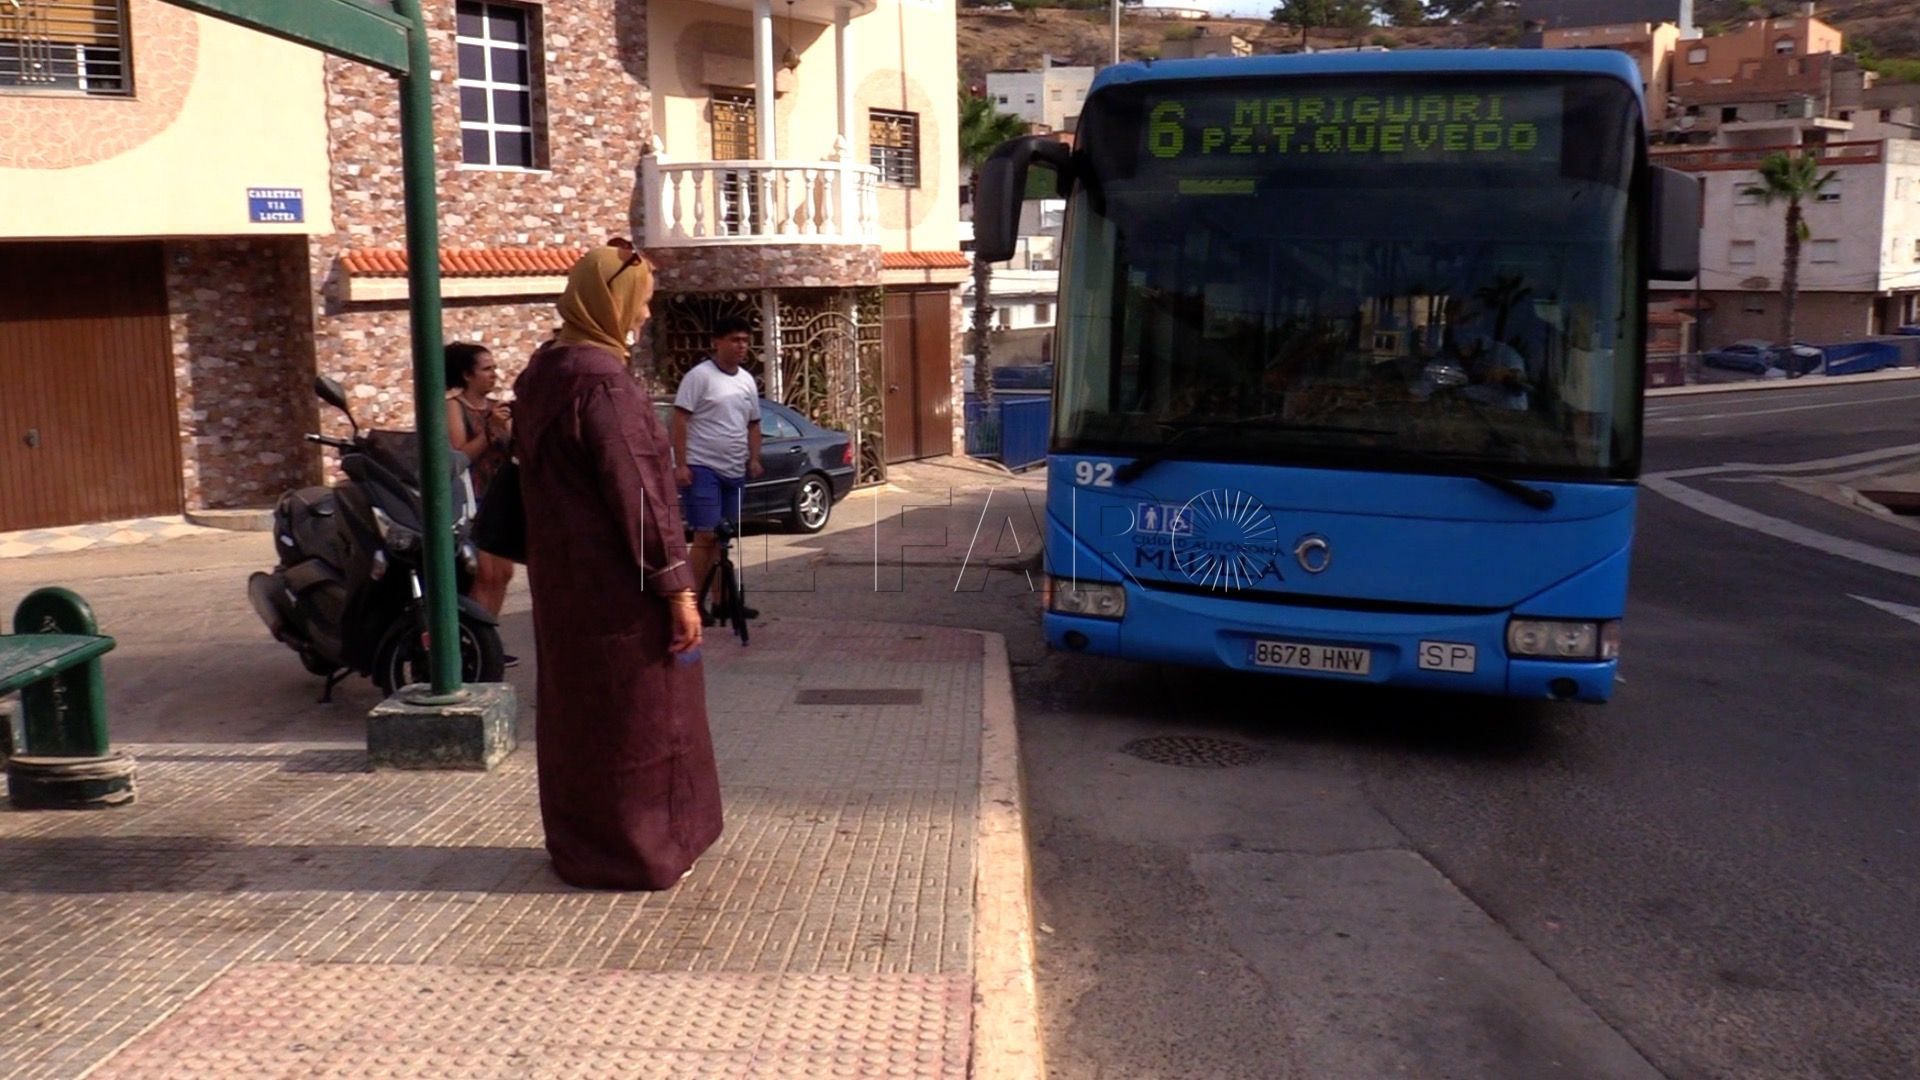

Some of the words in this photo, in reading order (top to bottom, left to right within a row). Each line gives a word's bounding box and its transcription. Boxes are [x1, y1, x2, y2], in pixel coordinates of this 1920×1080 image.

[1234, 94, 1503, 125] MARIGUARI
[1148, 101, 1185, 158] 6
[1201, 122, 1539, 153] PZ.T.QUEVEDO
[249, 190, 302, 199] CARRETERA
[267, 201, 286, 211] VIA
[1075, 460, 1115, 487] 92
[1257, 643, 1311, 666] 8678
[1322, 648, 1365, 671] HNV
[1426, 645, 1469, 668] SP
